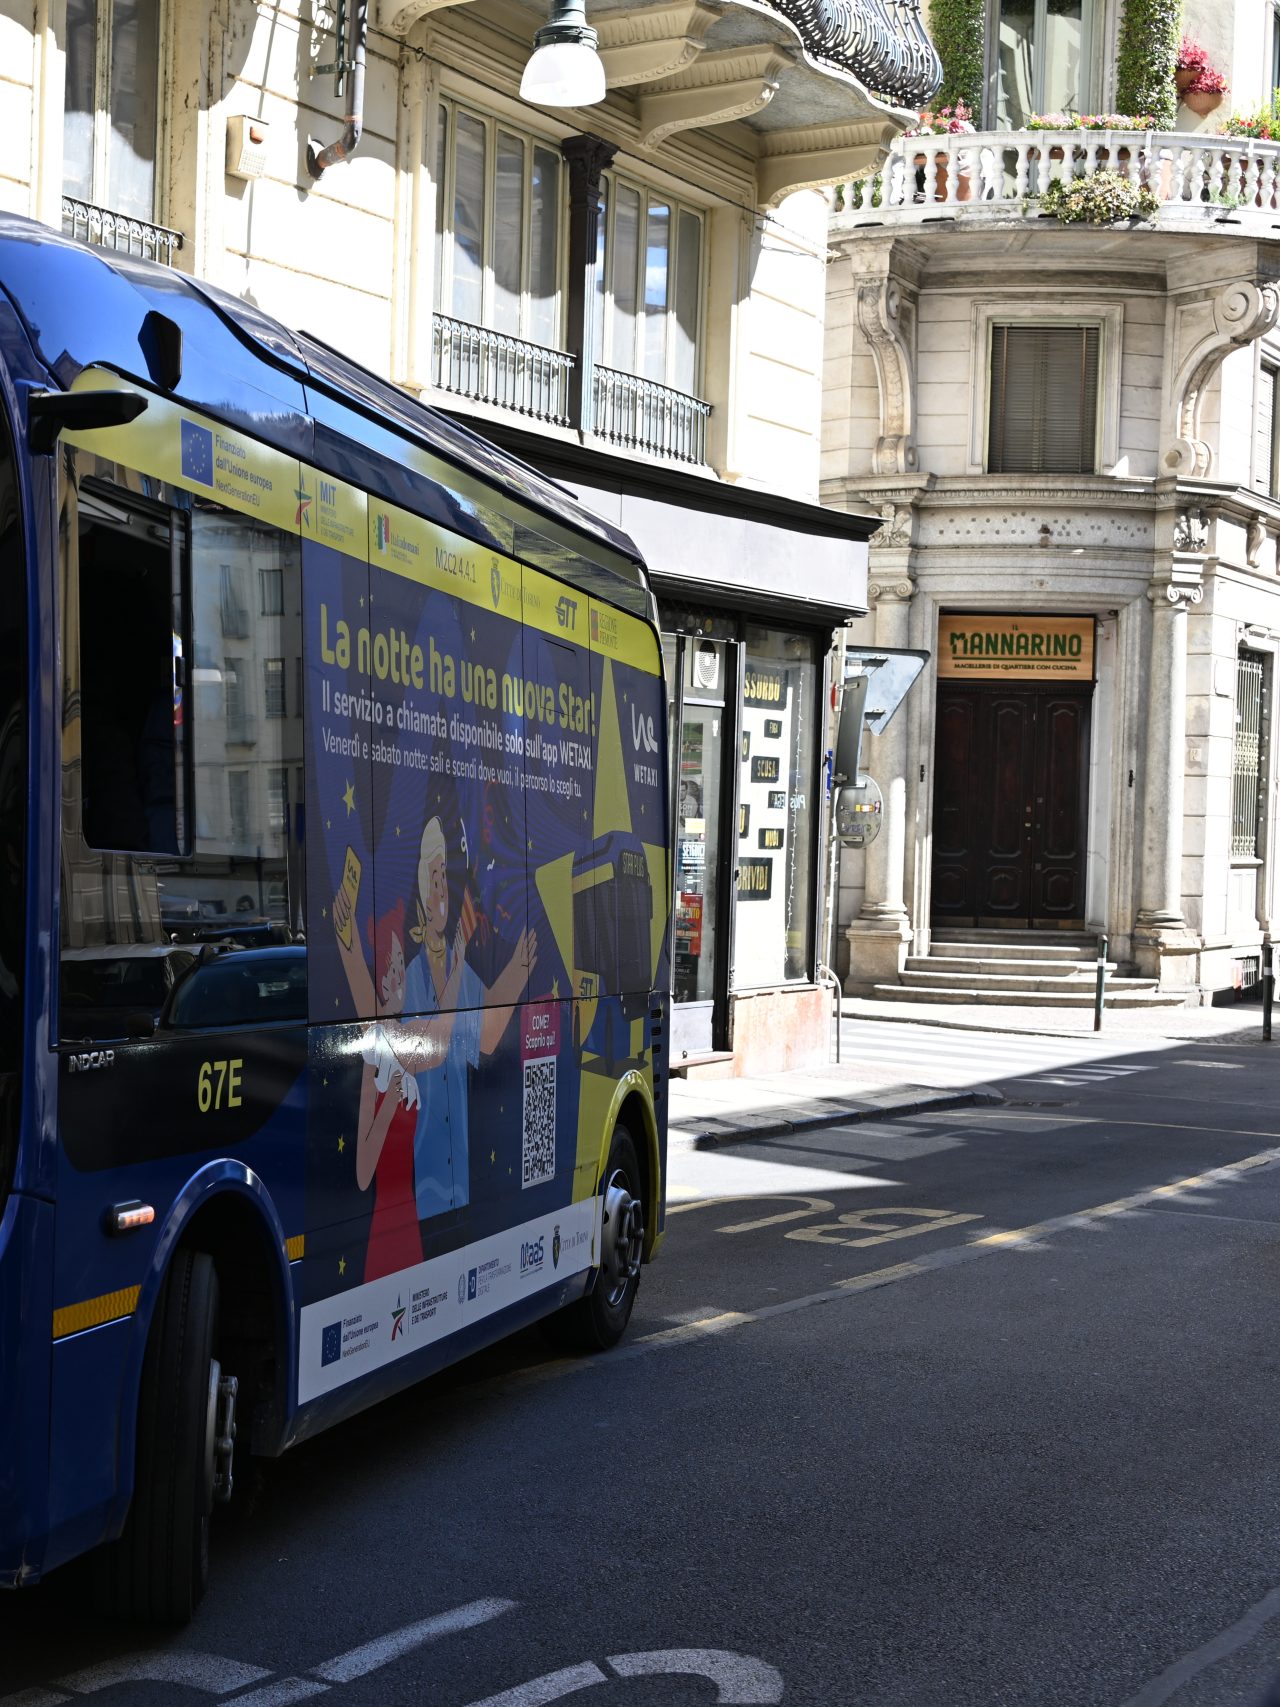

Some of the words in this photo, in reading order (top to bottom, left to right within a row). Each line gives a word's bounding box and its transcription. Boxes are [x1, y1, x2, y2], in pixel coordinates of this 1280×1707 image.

[320, 481, 337, 508] MIT
[435, 547, 457, 576] M2C2
[950, 632, 1082, 657] MANNARINO
[320, 603, 351, 670] La
[357, 627, 424, 690] notte
[429, 636, 456, 698] ha
[461, 660, 497, 710] una
[502, 673, 556, 726] nuova
[559, 683, 597, 737] Star!
[954, 662, 992, 670] MACELLERIE
[1001, 663, 1036, 671] QUARTIERE
[322, 679, 331, 713] Il
[334, 688, 384, 725] servizio
[386, 704, 394, 728] a
[396, 700, 448, 740] chiamata
[450, 713, 503, 754] disponibile
[505, 729, 525, 756] solo
[526, 734, 558, 768] sull'app
[322, 727, 361, 759] Venerdì
[363, 741, 369, 760] e
[371, 740, 402, 766] sabato
[403, 748, 429, 771] notte:
[430, 752, 444, 774] sali
[446, 760, 451, 774] e
[452, 759, 477, 780] scendi
[478, 763, 496, 783] dove
[514, 768, 519, 786] il
[520, 771, 548, 792] percorso
[549, 774, 555, 792] lo
[556, 778, 574, 800] scegli
[634, 763, 658, 788] WETAXI
[757, 760, 777, 778] SCUSA
[531, 1014, 550, 1031] COME?
[69, 1050, 116, 1073] INDCAR
[198, 1058, 243, 1113] 67E
